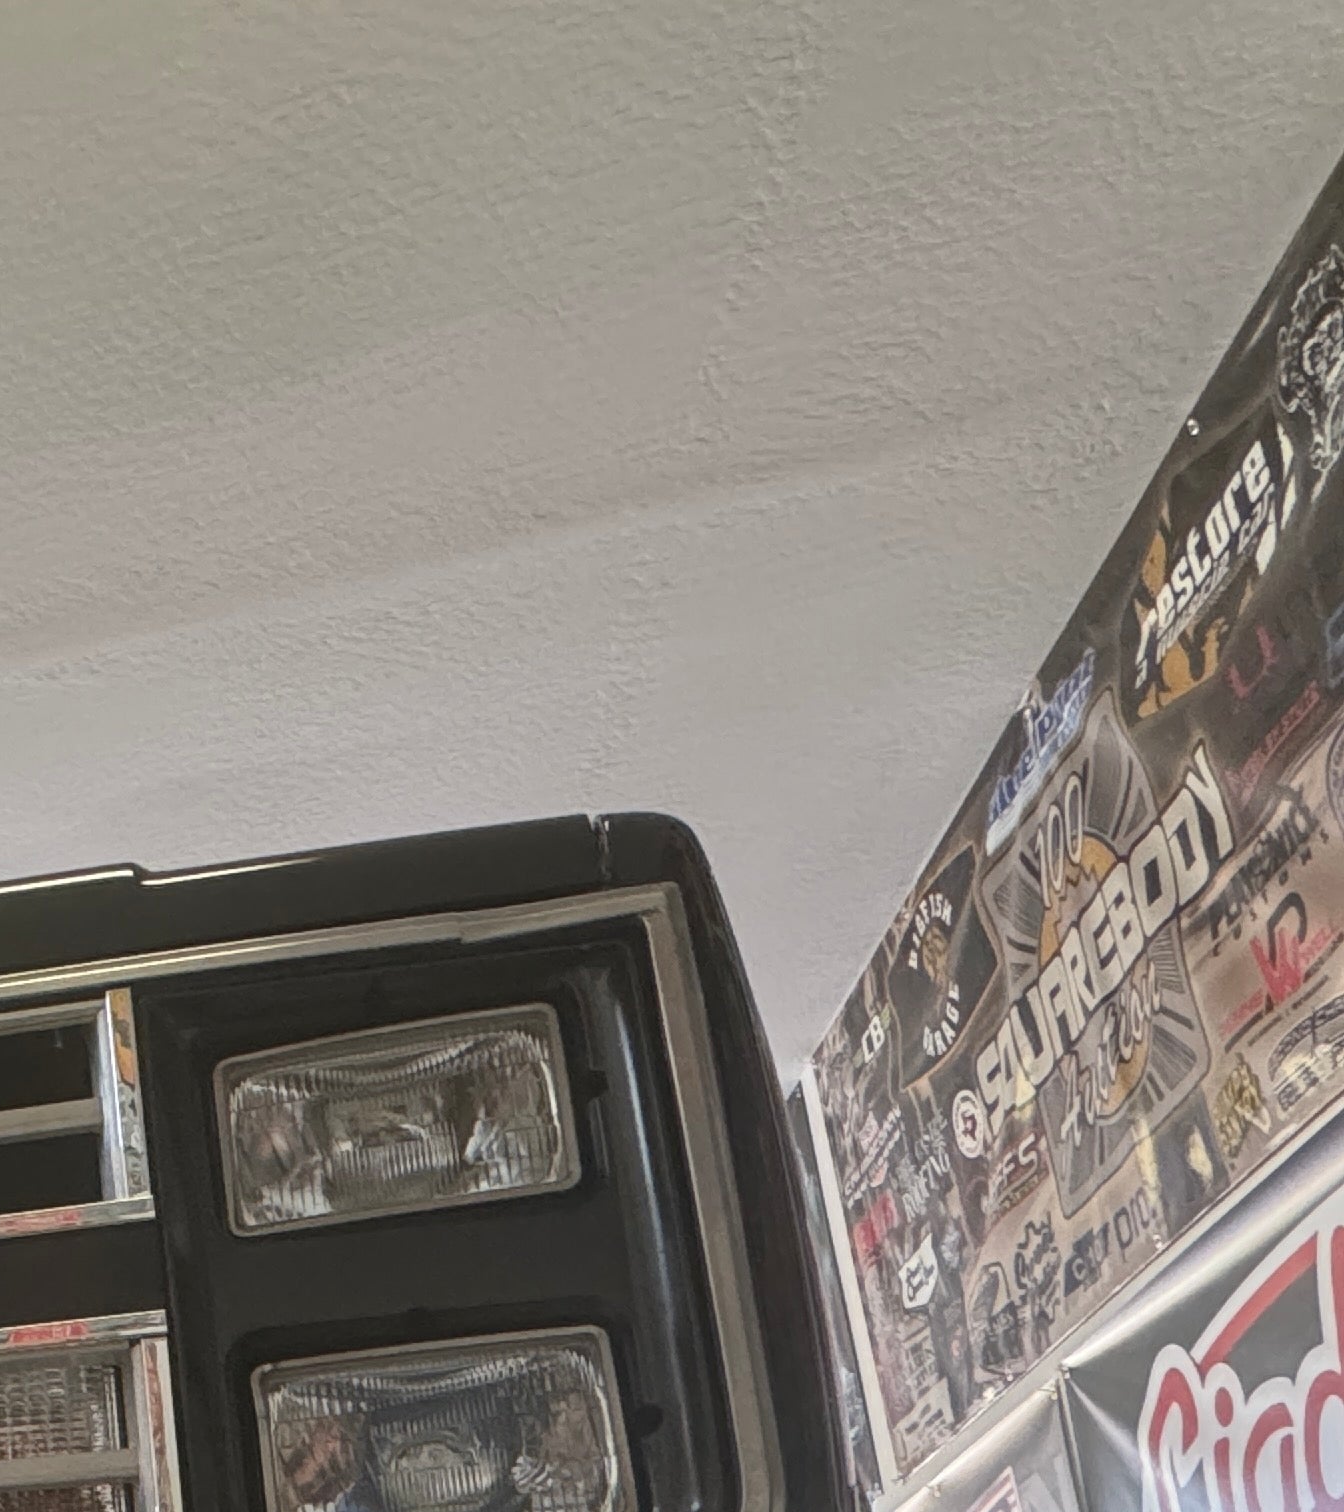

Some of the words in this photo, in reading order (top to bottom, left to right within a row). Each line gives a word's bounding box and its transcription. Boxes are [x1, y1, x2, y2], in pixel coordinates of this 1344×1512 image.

[1136, 440, 1272, 667] restore
[1237, 480, 1276, 556] car
[1033, 772, 1086, 907] 100
[975, 742, 1235, 1135] SQUAREBODY
